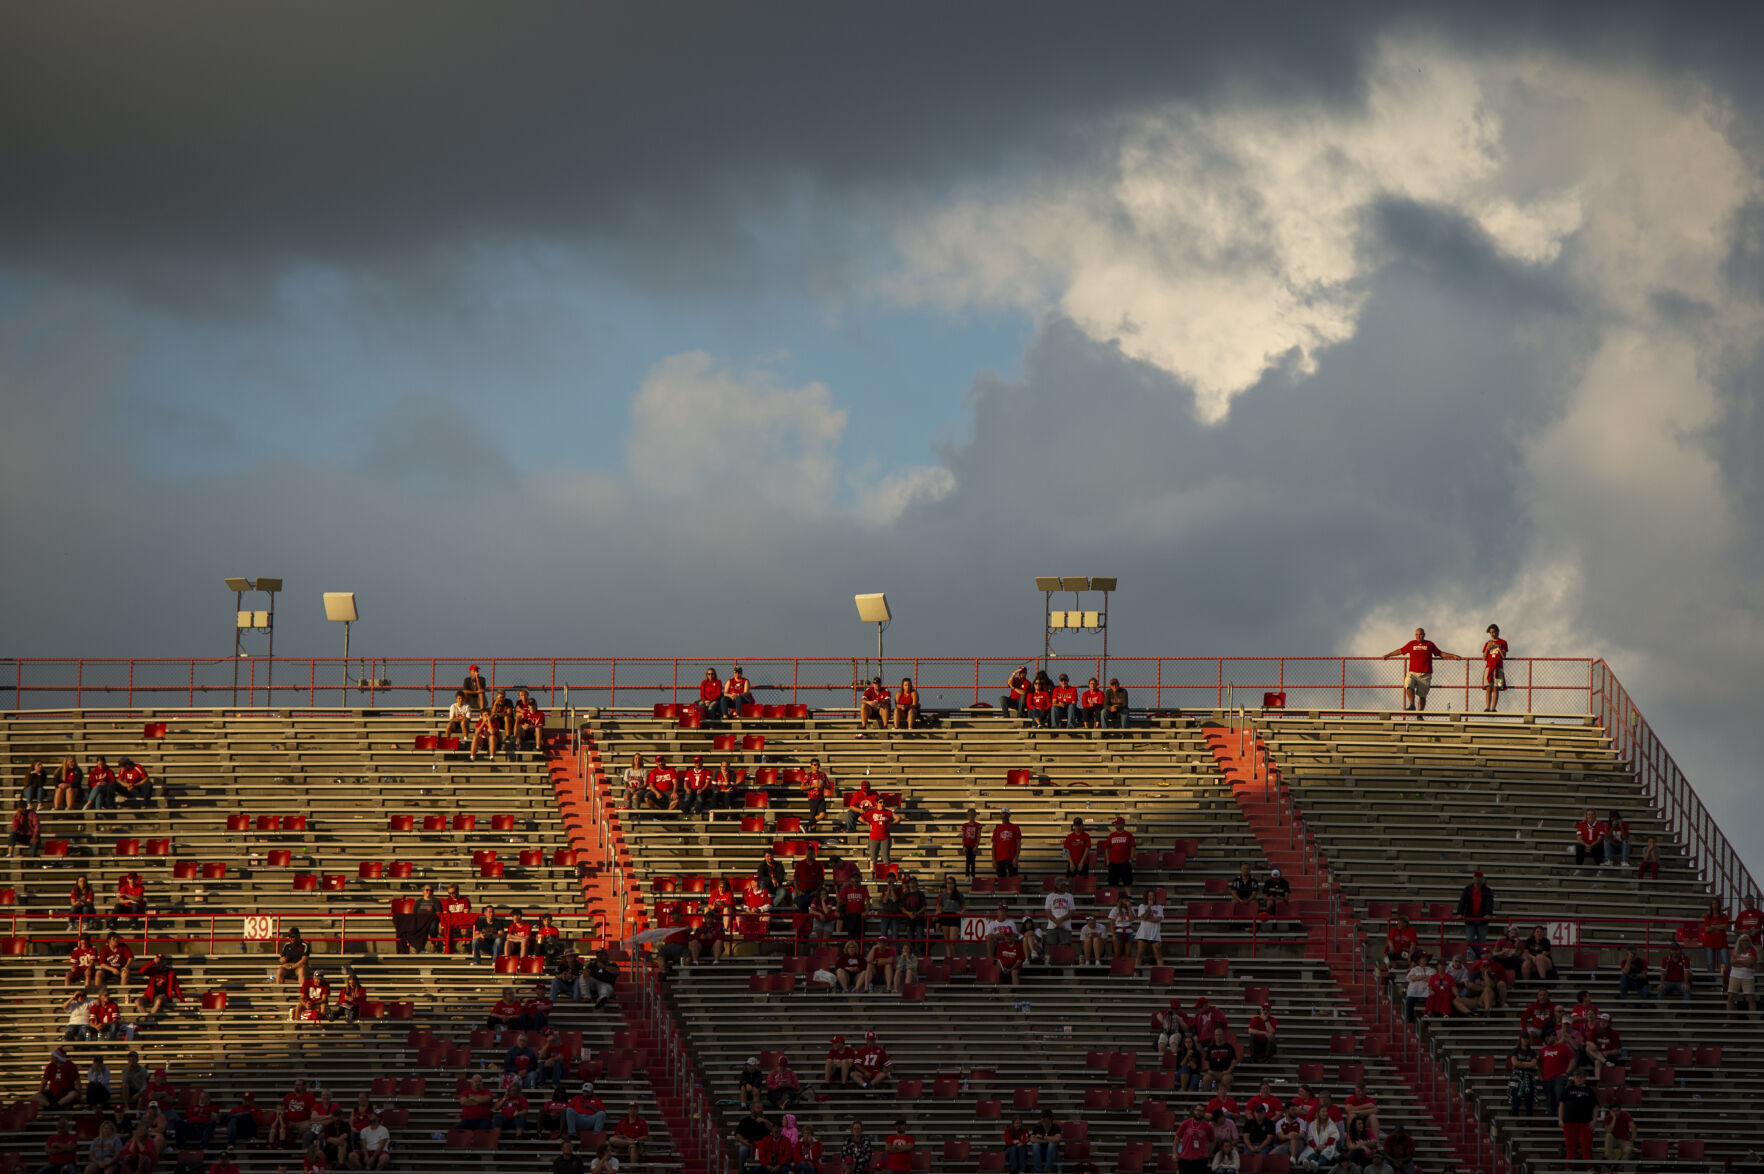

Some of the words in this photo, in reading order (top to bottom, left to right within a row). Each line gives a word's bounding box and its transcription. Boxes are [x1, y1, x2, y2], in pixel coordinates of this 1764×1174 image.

[248, 917, 268, 938] 39
[964, 919, 985, 940] 40
[1553, 923, 1570, 944] 41
[864, 1054, 878, 1066] 17
